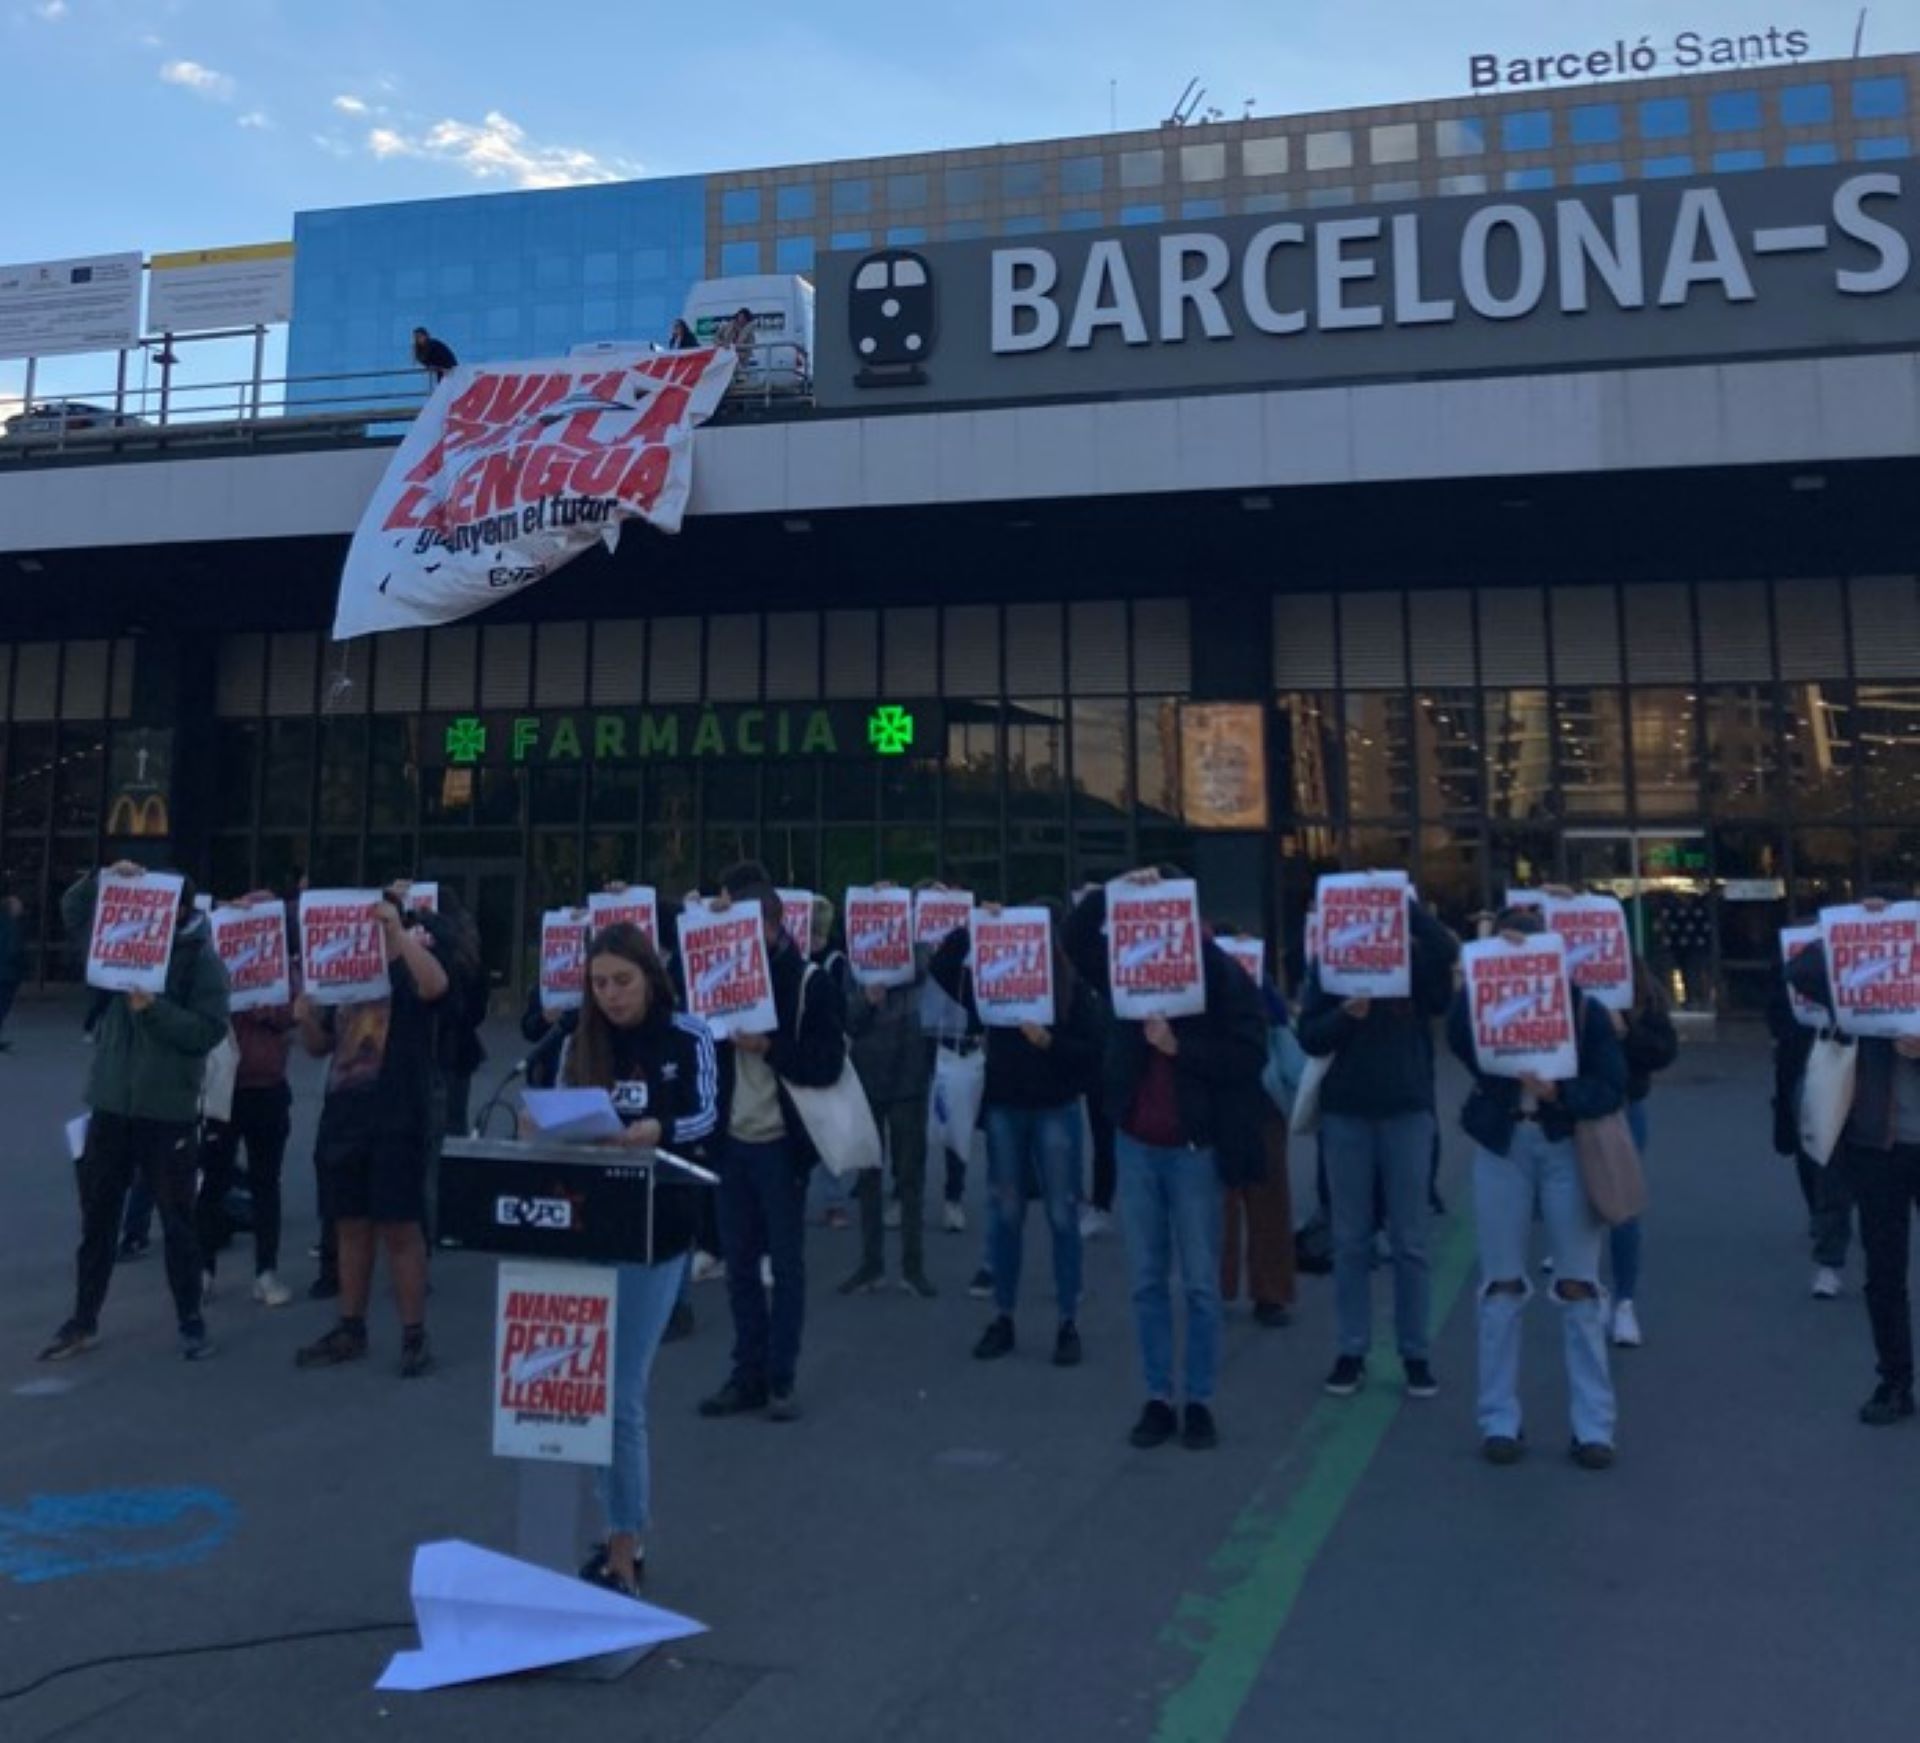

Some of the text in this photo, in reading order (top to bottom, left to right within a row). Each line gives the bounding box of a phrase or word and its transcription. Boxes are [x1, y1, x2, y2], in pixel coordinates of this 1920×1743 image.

[1468, 26, 1810, 89] Barceló Sants
[513, 703, 838, 761] FARMÀCIA
[500, 1376, 607, 1417] LLENGUA
